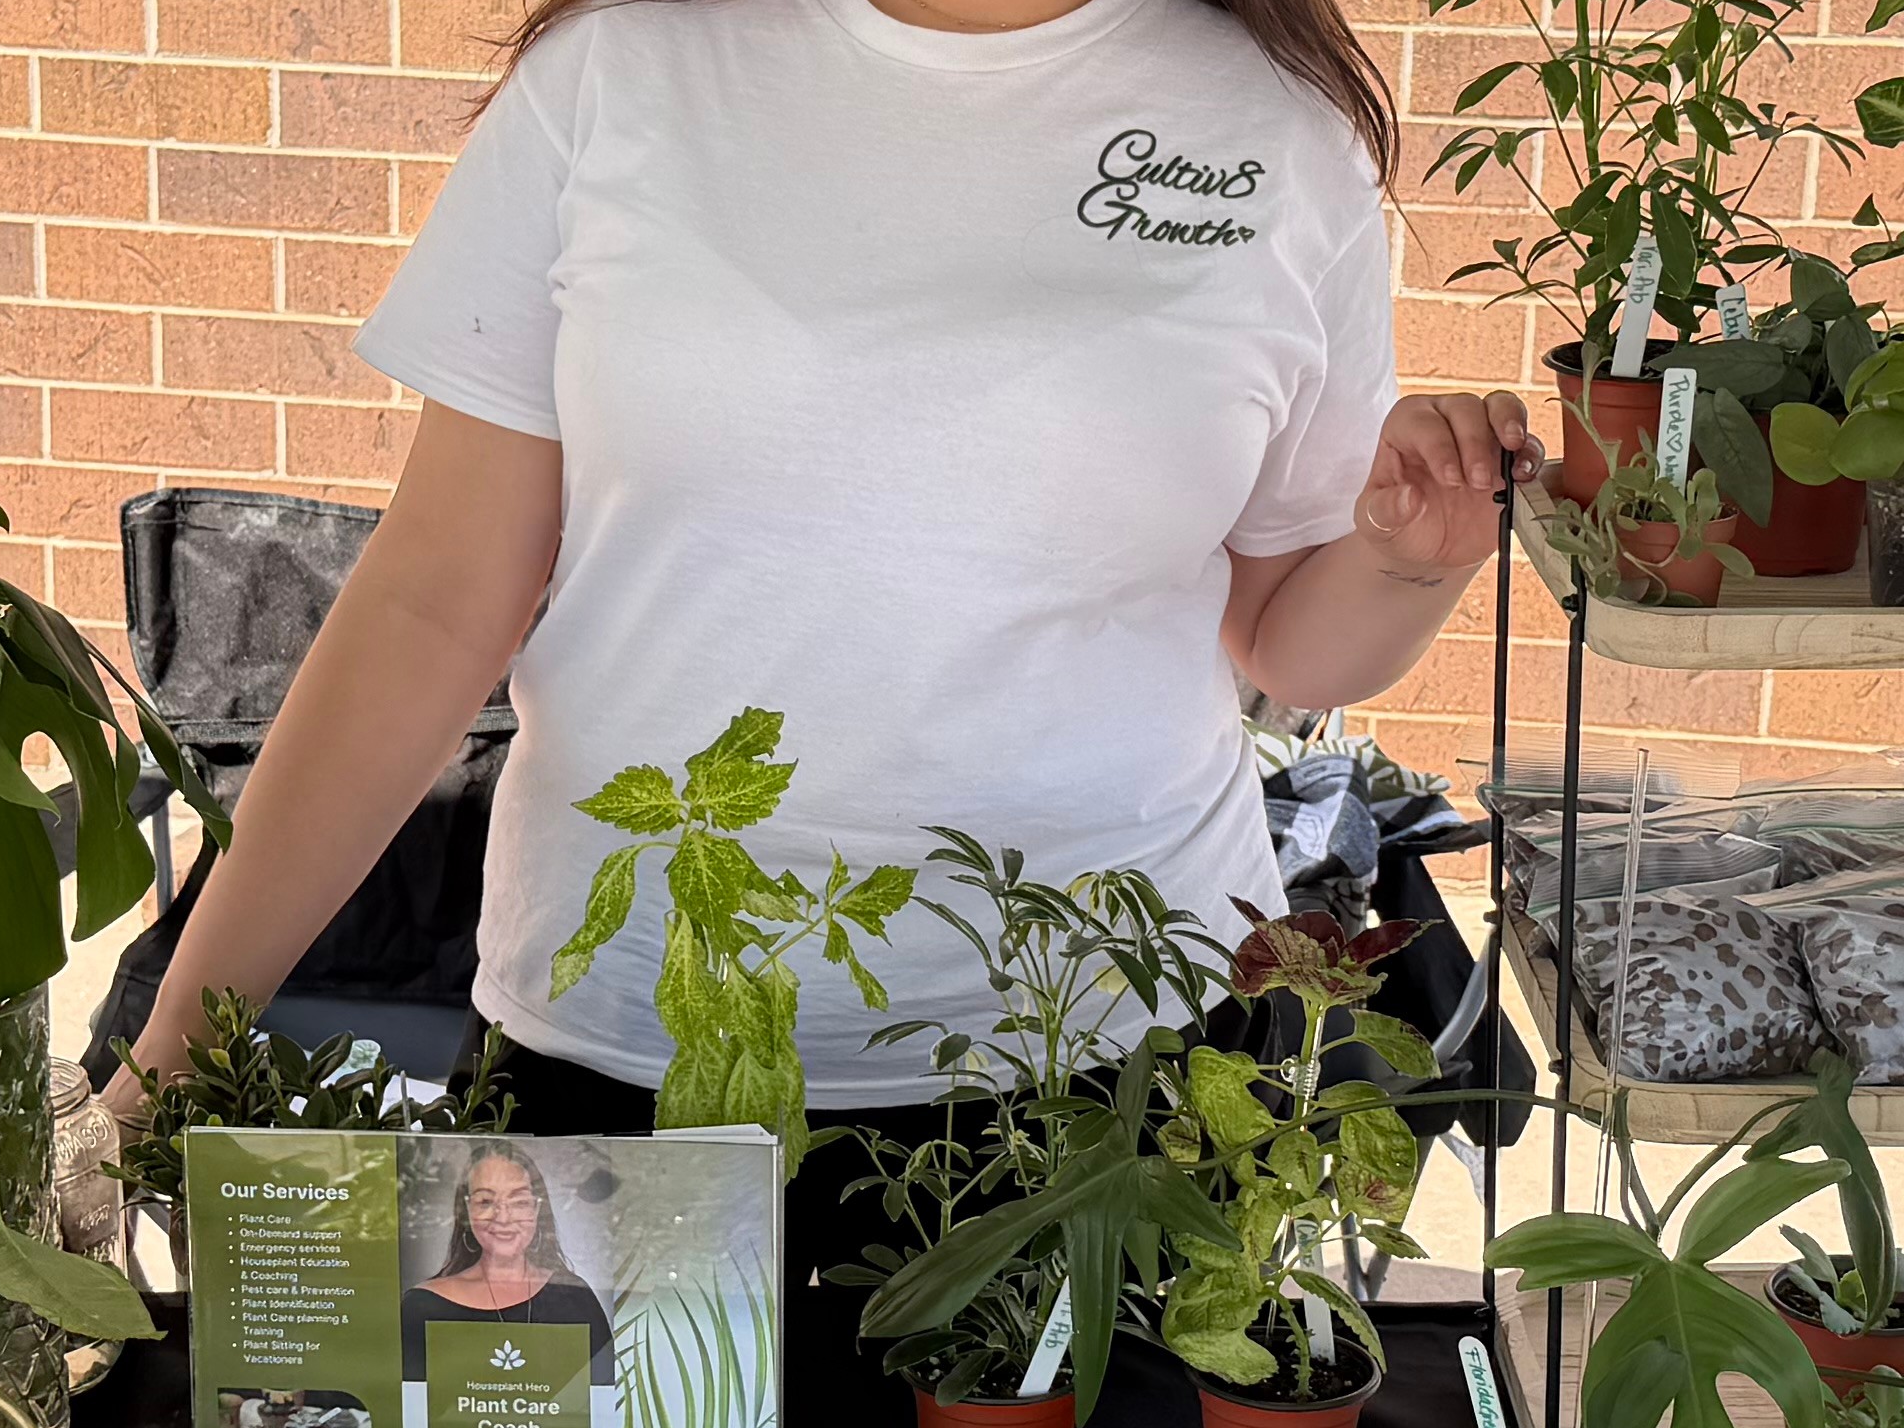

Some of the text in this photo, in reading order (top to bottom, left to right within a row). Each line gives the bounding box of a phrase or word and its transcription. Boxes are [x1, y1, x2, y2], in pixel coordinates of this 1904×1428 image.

[1098, 129, 1265, 199] Cultiv8
[1077, 180, 1236, 247] Growth
[221, 1182, 350, 1200] Our Services
[239, 1214, 292, 1224] Plant Care
[239, 1228, 342, 1241] On-Demand support
[240, 1242, 341, 1254] Emergency services
[240, 1256, 351, 1268] Houseplant Education
[250, 1271, 298, 1282] Coaching
[241, 1284, 264, 1294] Pest
[266, 1286, 289, 1295] care
[300, 1286, 355, 1296] Prevention
[241, 1299, 335, 1309] Plant Identification
[242, 1313, 349, 1325] Plant Care planning &
[243, 1326, 284, 1337] Training
[243, 1340, 321, 1352] Plant Sitting for
[243, 1354, 303, 1365] Vacationers
[466, 1381, 551, 1392] Houseplant Hero
[457, 1397, 561, 1415] Plant Care
